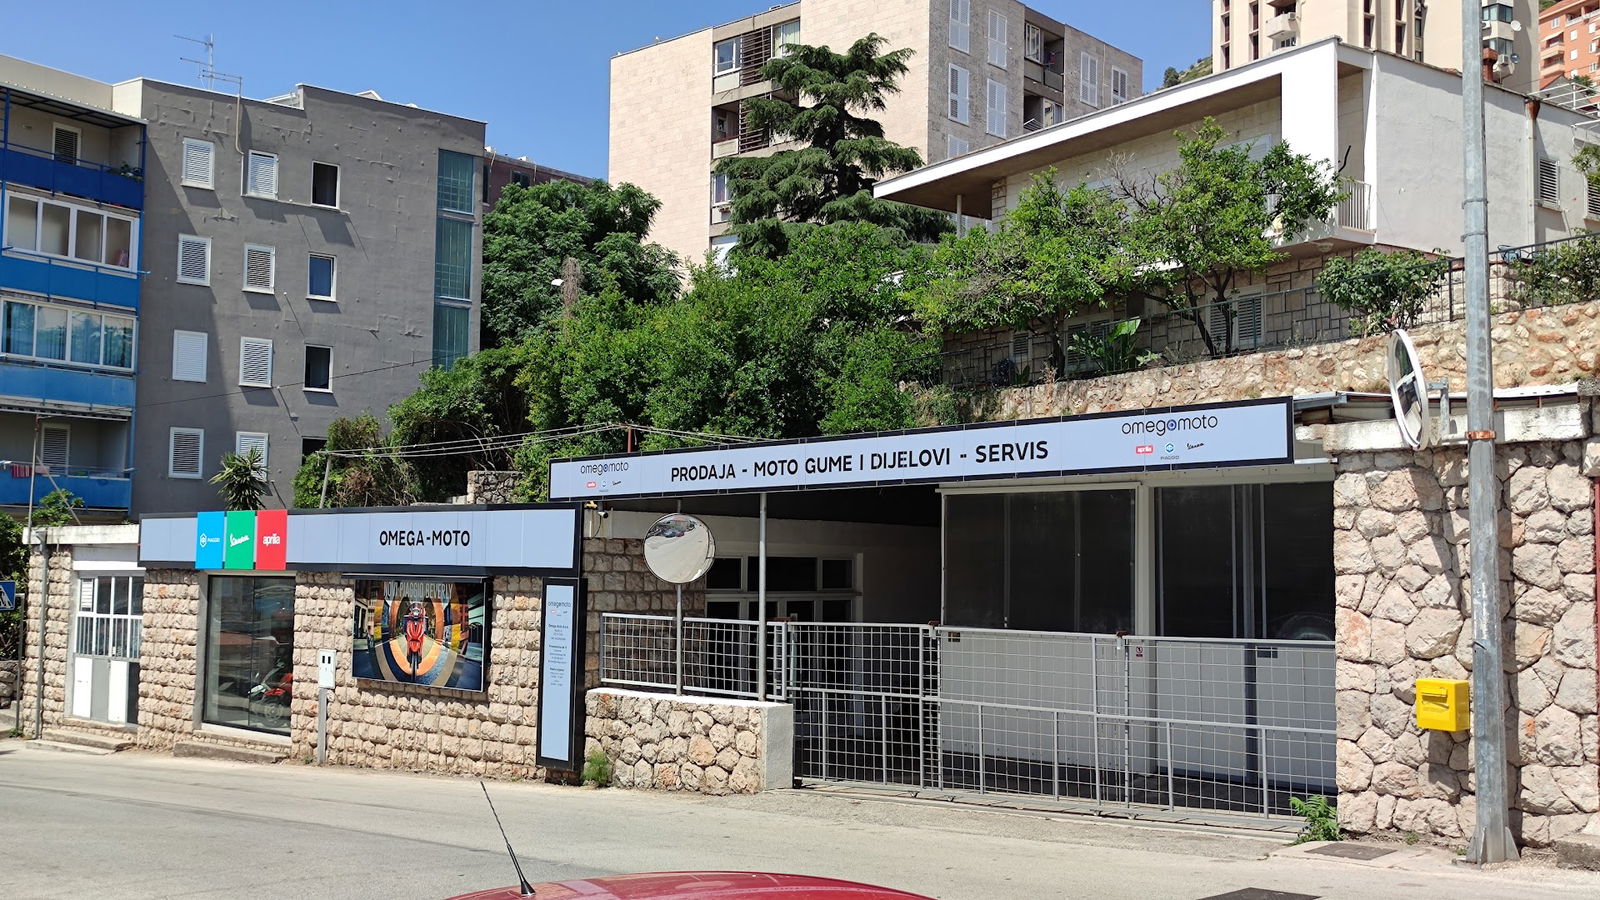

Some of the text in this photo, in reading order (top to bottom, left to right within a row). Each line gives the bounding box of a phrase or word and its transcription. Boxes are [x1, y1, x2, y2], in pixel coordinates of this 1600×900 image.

[671, 464, 736, 482] PRODAJA
[754, 459, 798, 477] MOTO
[805, 455, 853, 474] GUME
[871, 448, 950, 470] DIJELOVI
[975, 440, 1048, 463] SERVIS
[379, 530, 470, 546] OMEGA-MOTO
[425, 583, 453, 599] BEVERLY
